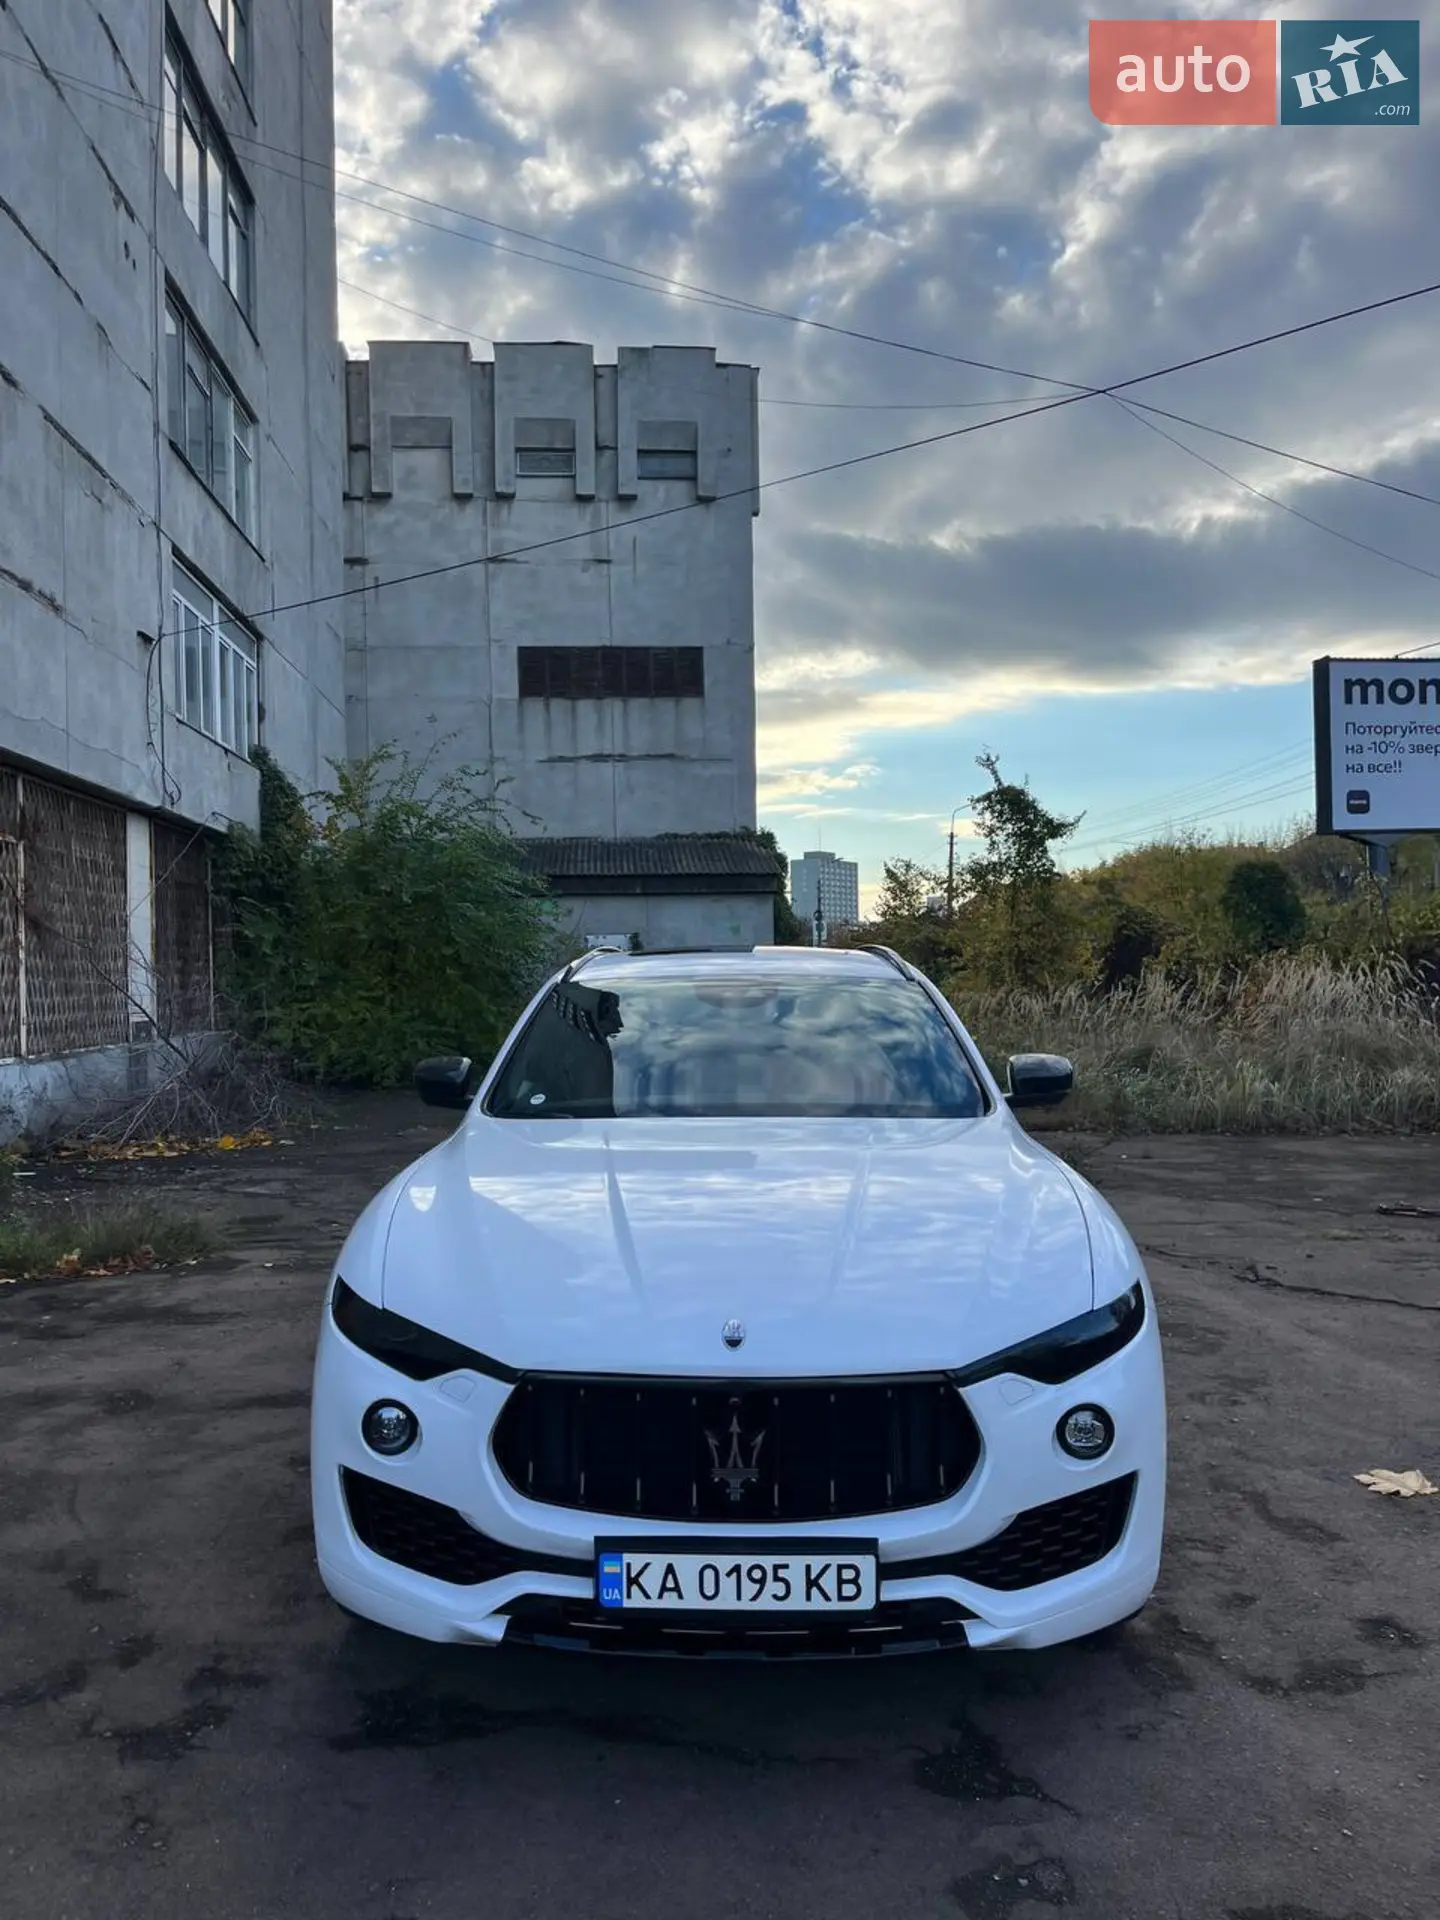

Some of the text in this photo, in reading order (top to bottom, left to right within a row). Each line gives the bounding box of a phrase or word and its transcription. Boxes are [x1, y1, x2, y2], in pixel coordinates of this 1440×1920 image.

[1345, 744, 1364, 754] на
[1367, 741, 1405, 754] -10%
[1345, 760, 1402, 773] на все!!
[625, 1562, 862, 1602] KA 0195 KB
[603, 1588, 621, 1600] UA
